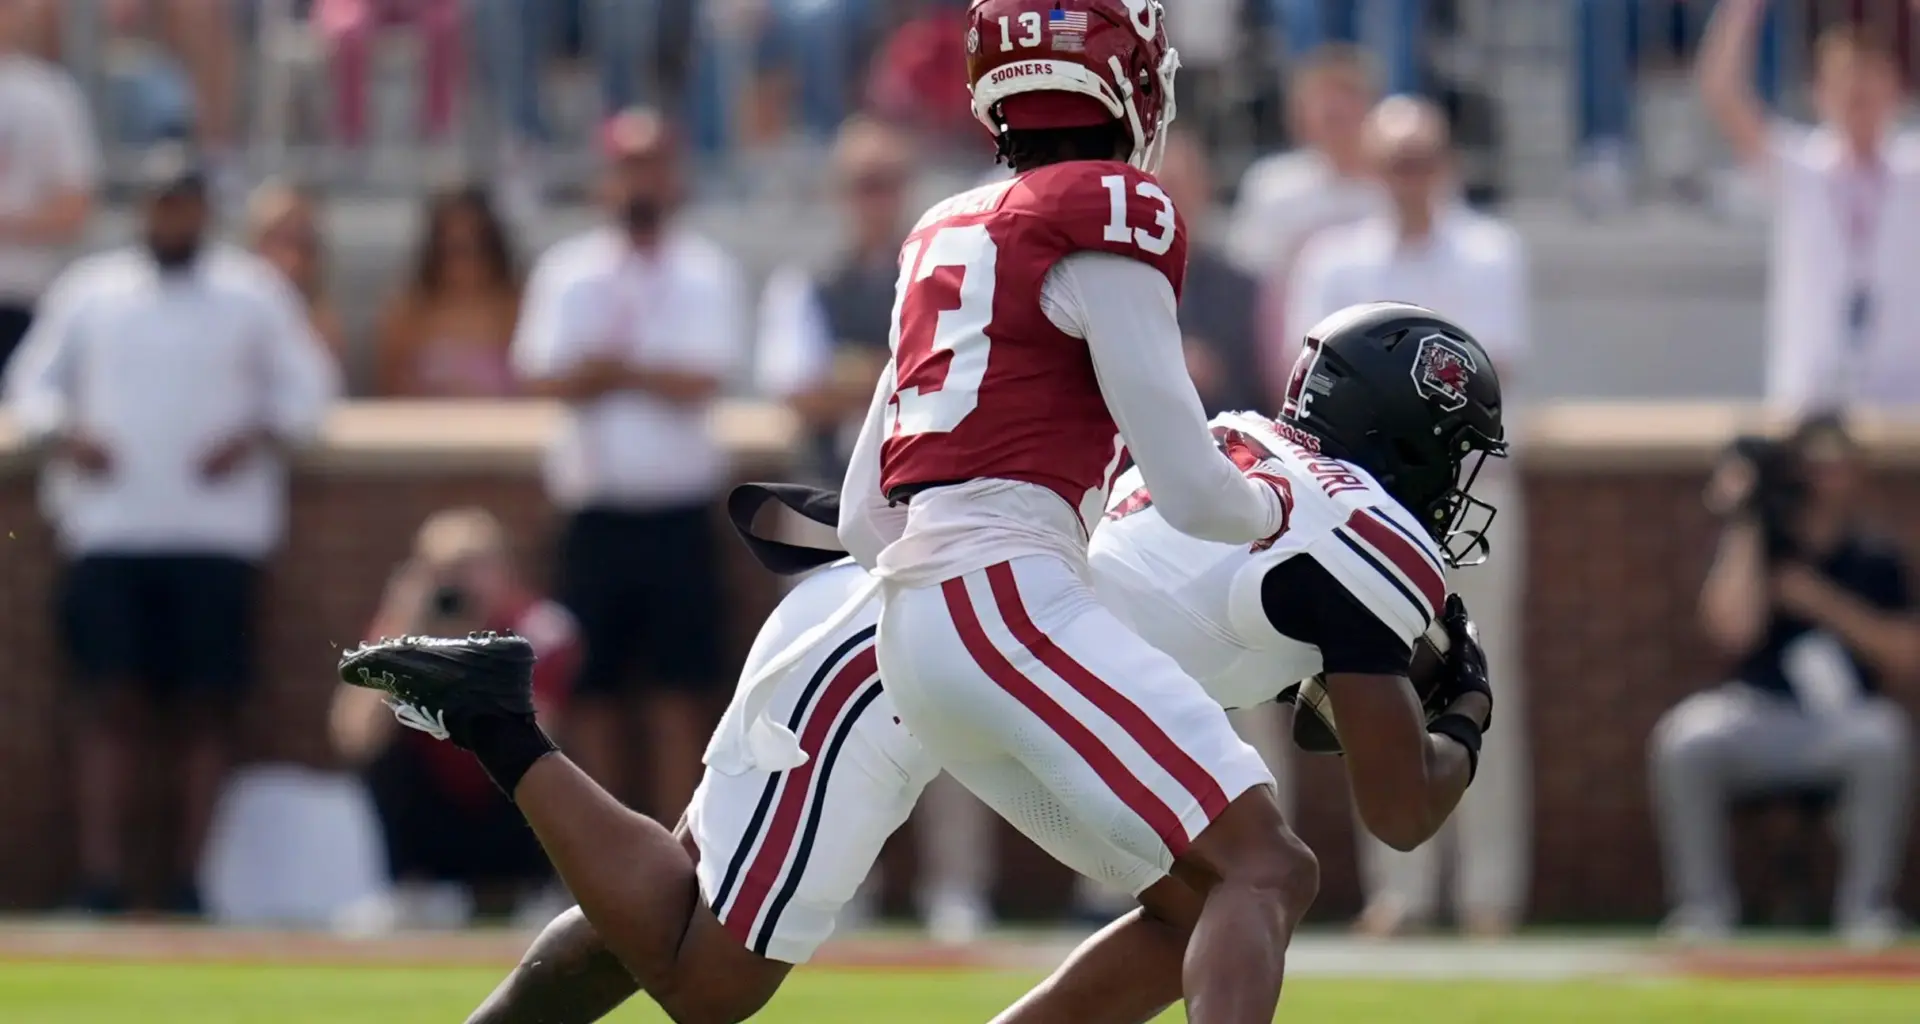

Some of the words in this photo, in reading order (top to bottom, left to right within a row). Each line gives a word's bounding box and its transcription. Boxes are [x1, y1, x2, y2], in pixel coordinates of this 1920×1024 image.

[998, 12, 1042, 51] 13
[991, 63, 1054, 85] SOONERS
[1101, 175, 1176, 255] 13
[884, 224, 998, 437] 13
[1300, 392, 1314, 418] C
